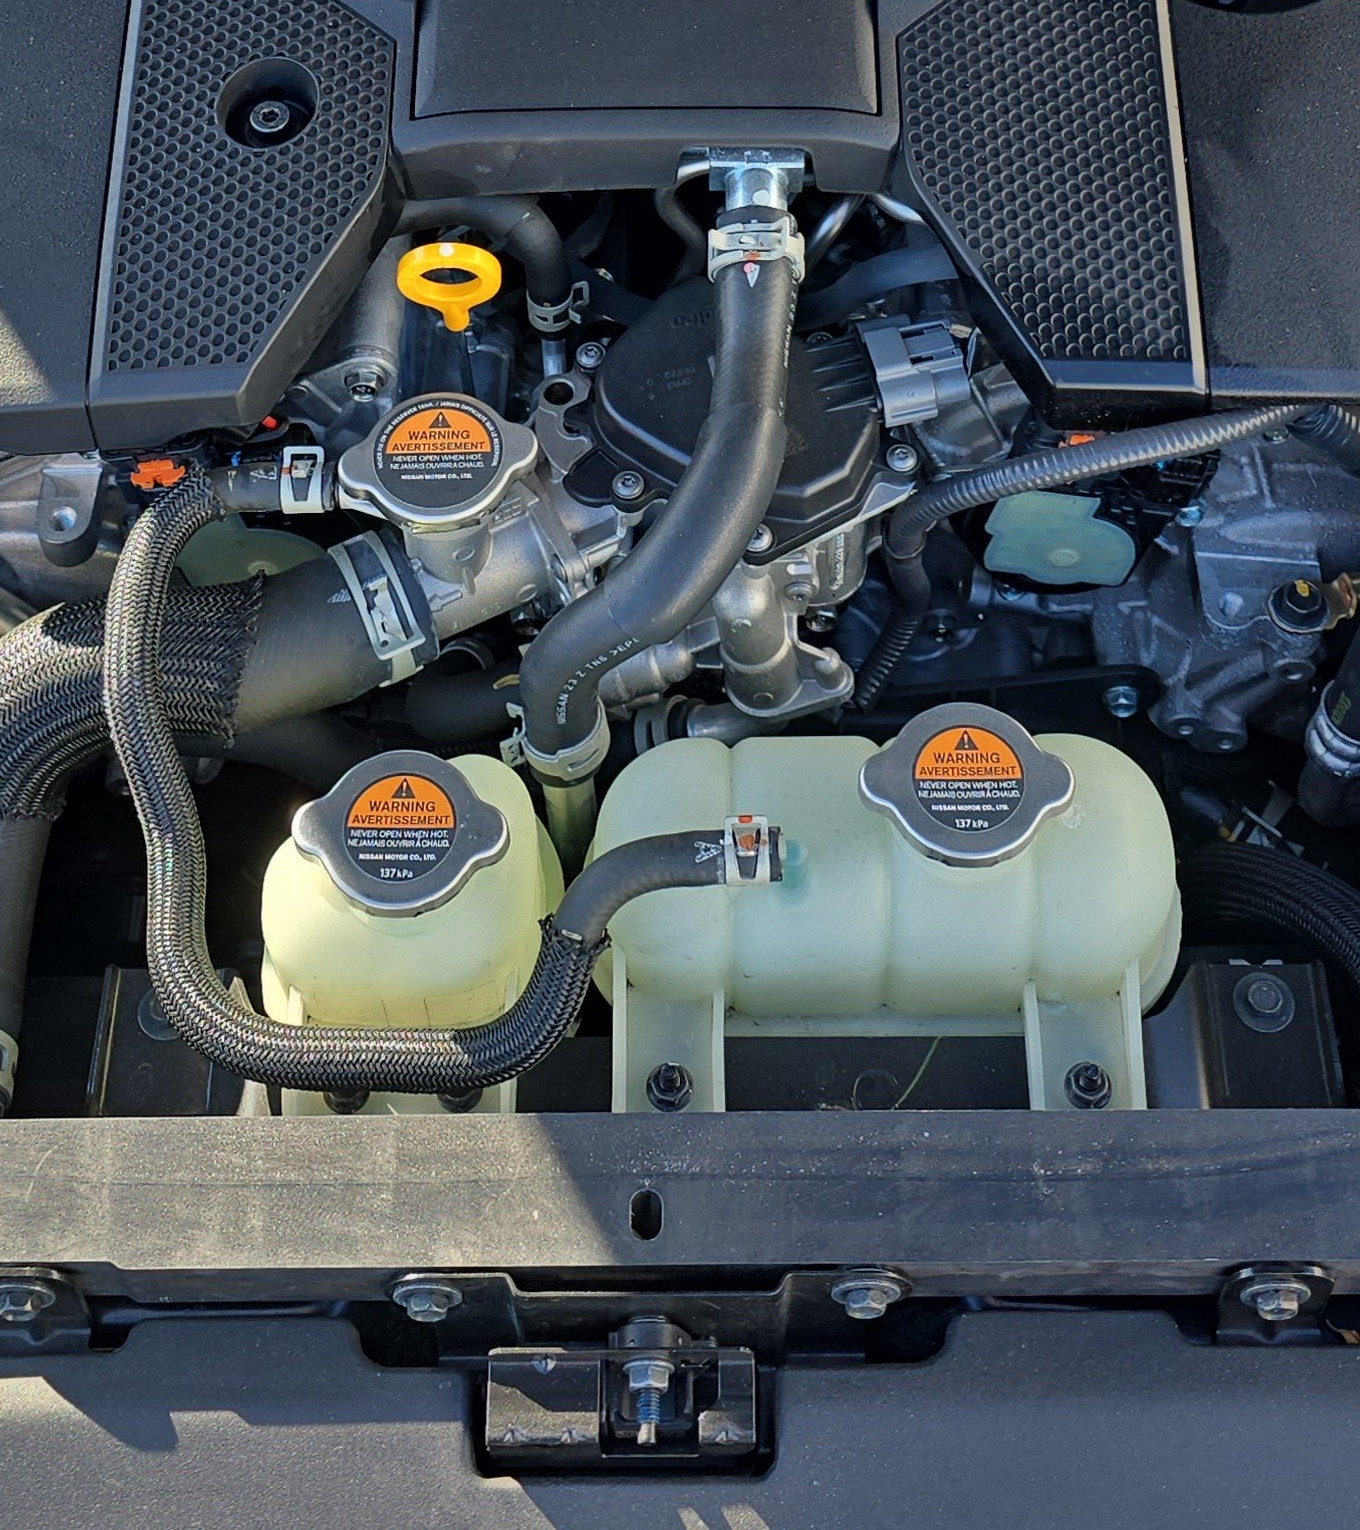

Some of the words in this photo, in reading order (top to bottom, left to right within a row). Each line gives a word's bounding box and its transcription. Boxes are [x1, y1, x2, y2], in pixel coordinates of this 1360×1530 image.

[408, 429, 471, 441] WARNING
[392, 441, 486, 452] AVERTISSEMENT
[392, 454, 417, 462] NEVER
[418, 454, 441, 462] OPEN
[441, 453, 465, 461] WHEN
[933, 752, 1001, 764] WARNING
[919, 765, 1016, 777] AVERTISSEMENT
[919, 781, 947, 789] NEVER
[948, 781, 971, 789] OPEN
[971, 781, 998, 789] WHEN
[369, 800, 436, 813] WARNING
[351, 814, 451, 825] AVERTISSEMENT
[954, 818, 971, 828] 137
[972, 819, 989, 828] kPa
[350, 829, 378, 838] NEVER
[379, 829, 402, 838] OPEN
[403, 830, 429, 838] WHEN
[380, 867, 397, 878] 137
[396, 868, 414, 878] kPa
